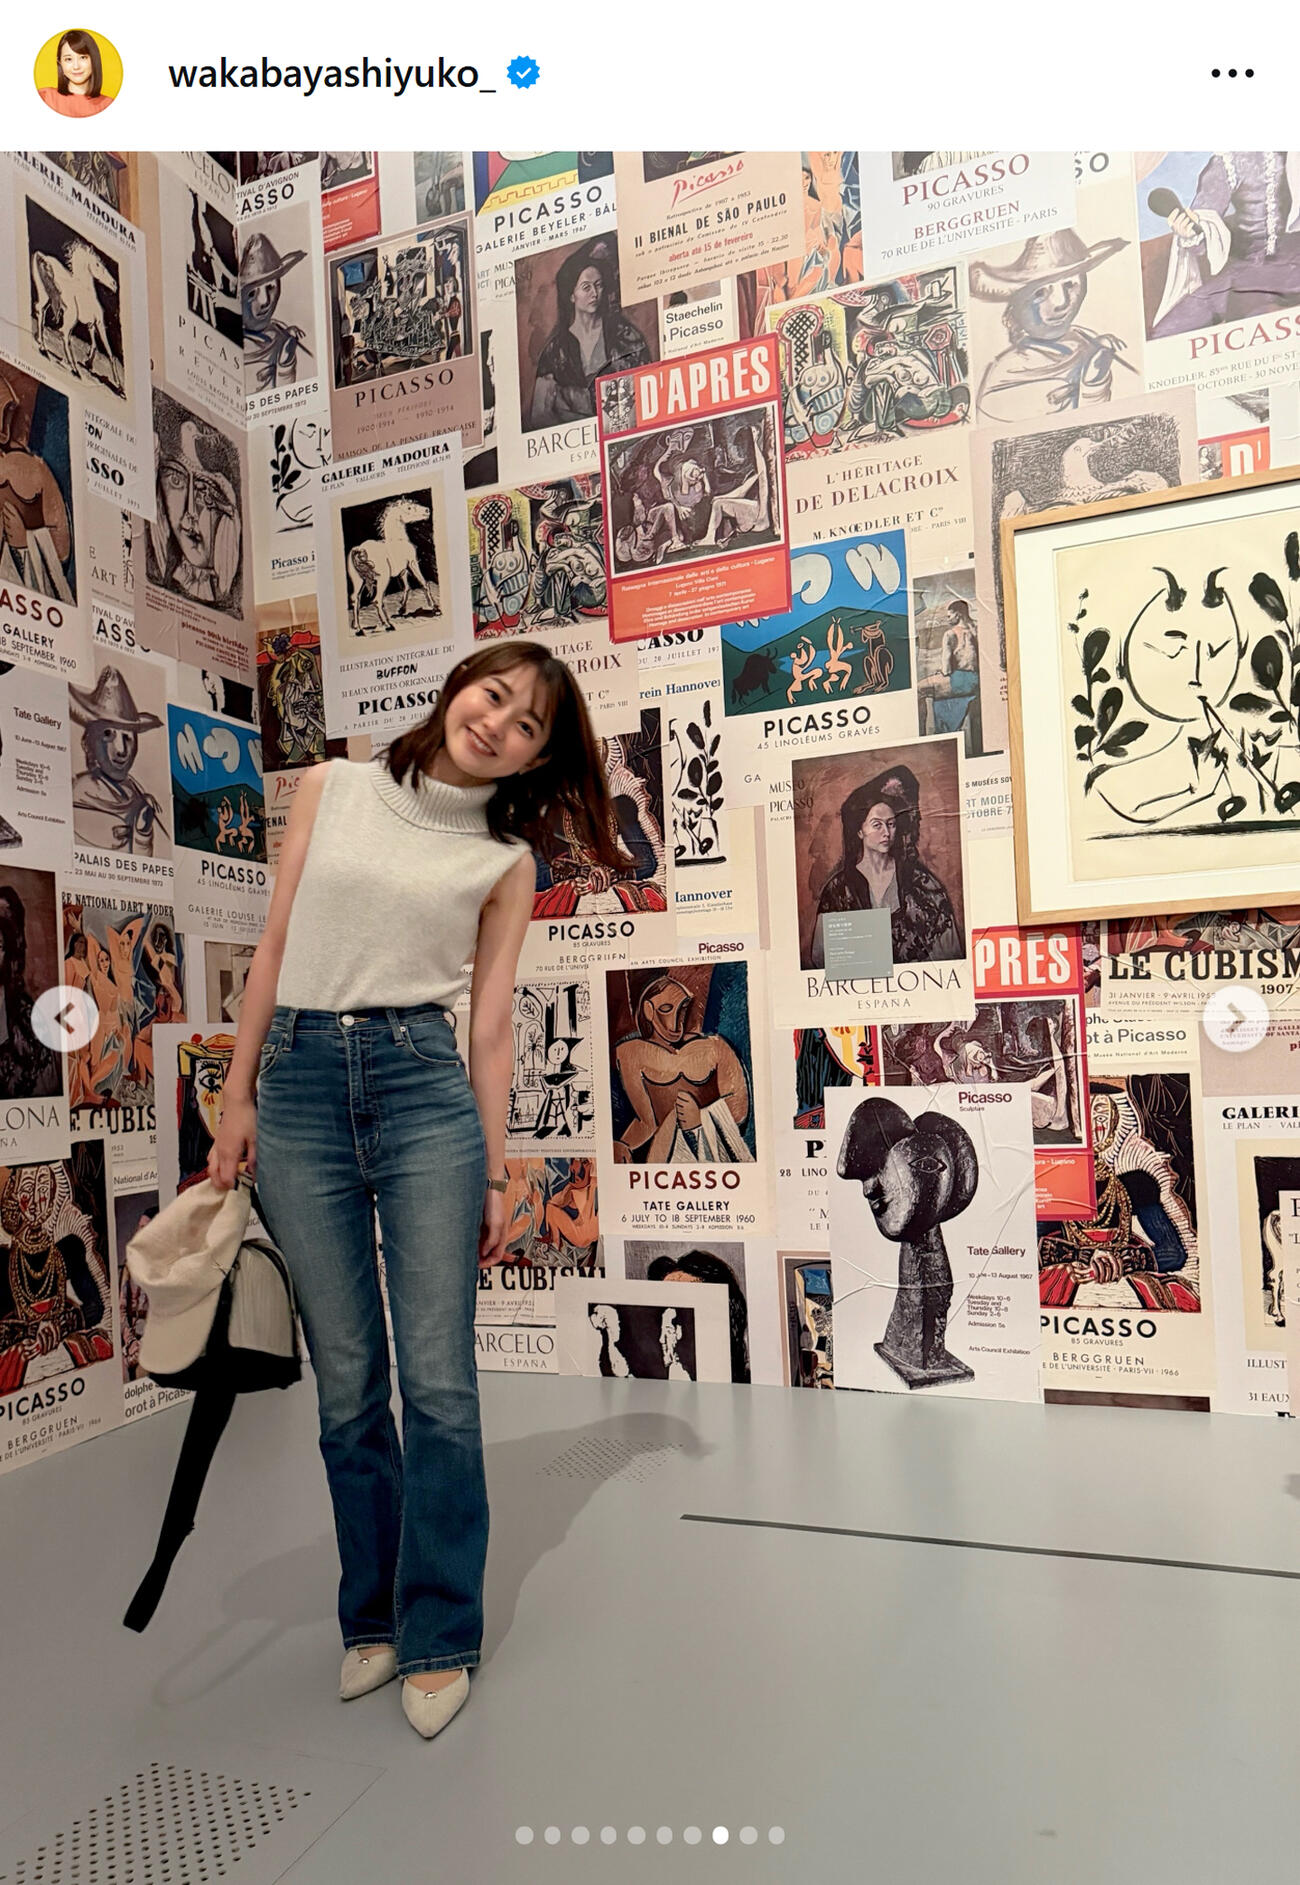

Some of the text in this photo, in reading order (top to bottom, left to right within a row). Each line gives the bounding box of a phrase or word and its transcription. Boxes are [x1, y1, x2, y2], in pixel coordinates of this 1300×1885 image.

[671, 159, 745, 208] Picasso
[902, 152, 1030, 206] PICASSO
[927, 184, 1005, 212] 90 GRAVURES
[71, 187, 136, 244] MADOURA
[494, 185, 602, 233] PICASSO
[532, 212, 586, 238] BEYELER
[635, 192, 788, 249] II BIENAL DE SÃO PAULO
[914, 200, 1020, 240] BERGGRUEN
[512, 238, 541, 253] JANVIER
[549, 230, 569, 241] MARS
[881, 207, 1058, 259] 70 RUE DE PARIS
[669, 231, 754, 263] aberta 15 de fevereiro
[665, 301, 724, 325] Staechelin
[669, 318, 724, 343] Picasso
[1254, 356, 1270, 367] DU
[354, 368, 455, 408] PICASSO
[1197, 373, 1247, 391] OCTOBRE
[260, 382, 319, 408] DES PAPES
[86, 457, 125, 487] SSO
[321, 442, 450, 484] GALERIE MADOURA
[795, 465, 960, 515] DE DELACROIX
[812, 531, 826, 542] M.
[907, 510, 925, 523] ET
[271, 554, 309, 570] Picasso
[91, 566, 117, 586] ART
[3, 623, 55, 650] GALLERY
[11, 640, 56, 664] SEPTEMBER
[59, 656, 78, 670] 1960
[668, 649, 701, 661] JUILLET
[376, 663, 419, 680] BUFFON
[350, 687, 369, 698] EAUX
[358, 689, 441, 716] PICASSO
[13, 706, 62, 730] Tate Gallery
[764, 705, 871, 739] PICASSO
[757, 741, 770, 750] 45
[744, 774, 762, 784] GA
[769, 796, 815, 813] PICASSO
[116, 858, 138, 872] DES
[142, 863, 175, 878] PAPES
[201, 859, 267, 886] PICASSO
[75, 894, 118, 912] NATIONAL
[188, 904, 256, 922] GALERIE LOUISE
[548, 920, 636, 942] PICASSO
[582, 940, 612, 949] GRAVURES
[698, 941, 745, 955] Picasso
[544, 963, 565, 972] RUE DE
[641, 955, 722, 966] ARTS COUNCIL EXHIBITION
[1109, 953, 1151, 981] LE
[807, 968, 962, 998] BARCELONA
[857, 997, 912, 1010] ESPAÑA
[1119, 991, 1156, 999] JANVIER
[1103, 1028, 1187, 1043] à Picasso
[958, 1091, 1013, 1104] Picasso
[1222, 1121, 1261, 1130] LE PLAN
[113, 1173, 143, 1185] National
[629, 1170, 741, 1190] PICASSO
[801, 1166, 828, 1177] LINO
[643, 1201, 730, 1211] TATE GALLERY
[621, 1214, 756, 1224] 6 JULY TO 18 SEPTEMBER 1960
[967, 1245, 990, 1256] Tate
[967, 1320, 997, 1328] Admission
[1083, 1338, 1124, 1347] GRAVURES
[1053, 1352, 1145, 1366] BERGGRUEN
[1247, 1358, 1287, 1369] ILLUST
[1049, 1362, 1180, 1377] DE 1966
[124, 1380, 153, 1400] dolphe
[1248, 1392, 1258, 1402] 31
[32, 1405, 62, 1422] GRAVURES
[125, 1401, 147, 1419] orot
[7, 1416, 78, 1450] BERGGRUEN
